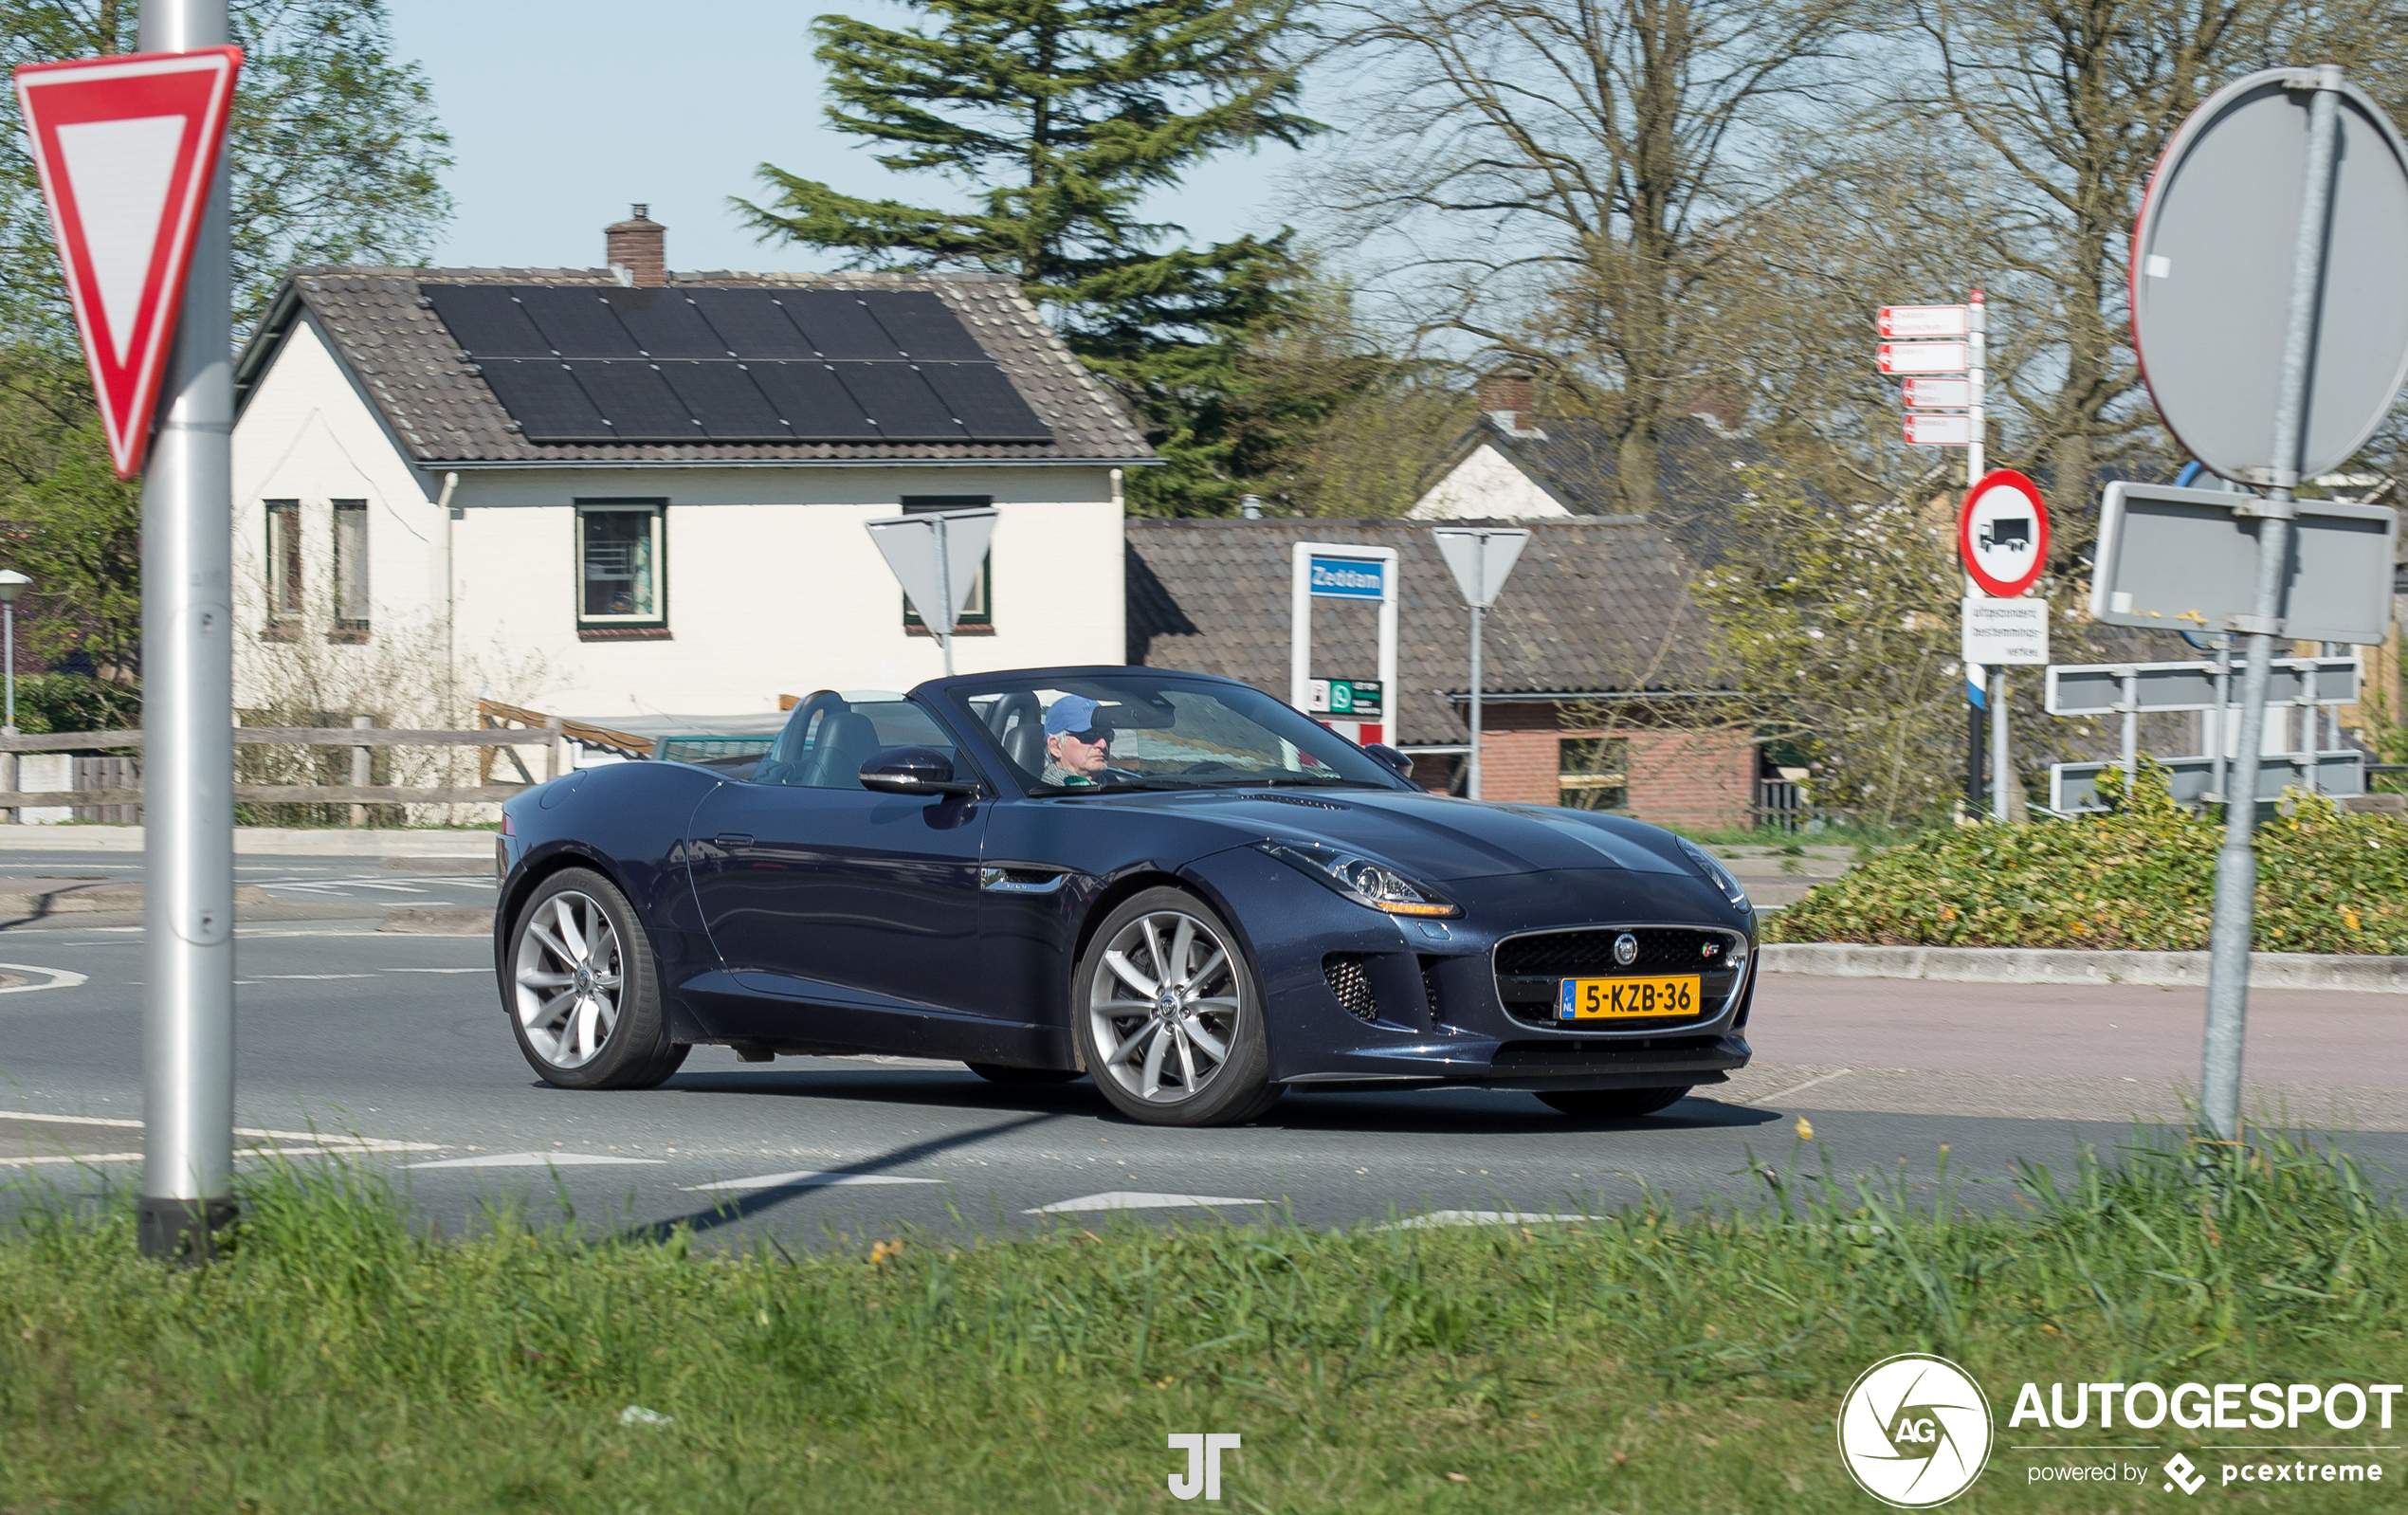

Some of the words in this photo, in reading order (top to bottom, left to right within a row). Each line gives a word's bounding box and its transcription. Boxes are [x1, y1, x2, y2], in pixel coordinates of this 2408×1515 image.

[1311, 565, 1381, 590] Zeddam
[1562, 1002, 1574, 1013] NL
[1586, 982, 1690, 1013] 5-KZB-36
